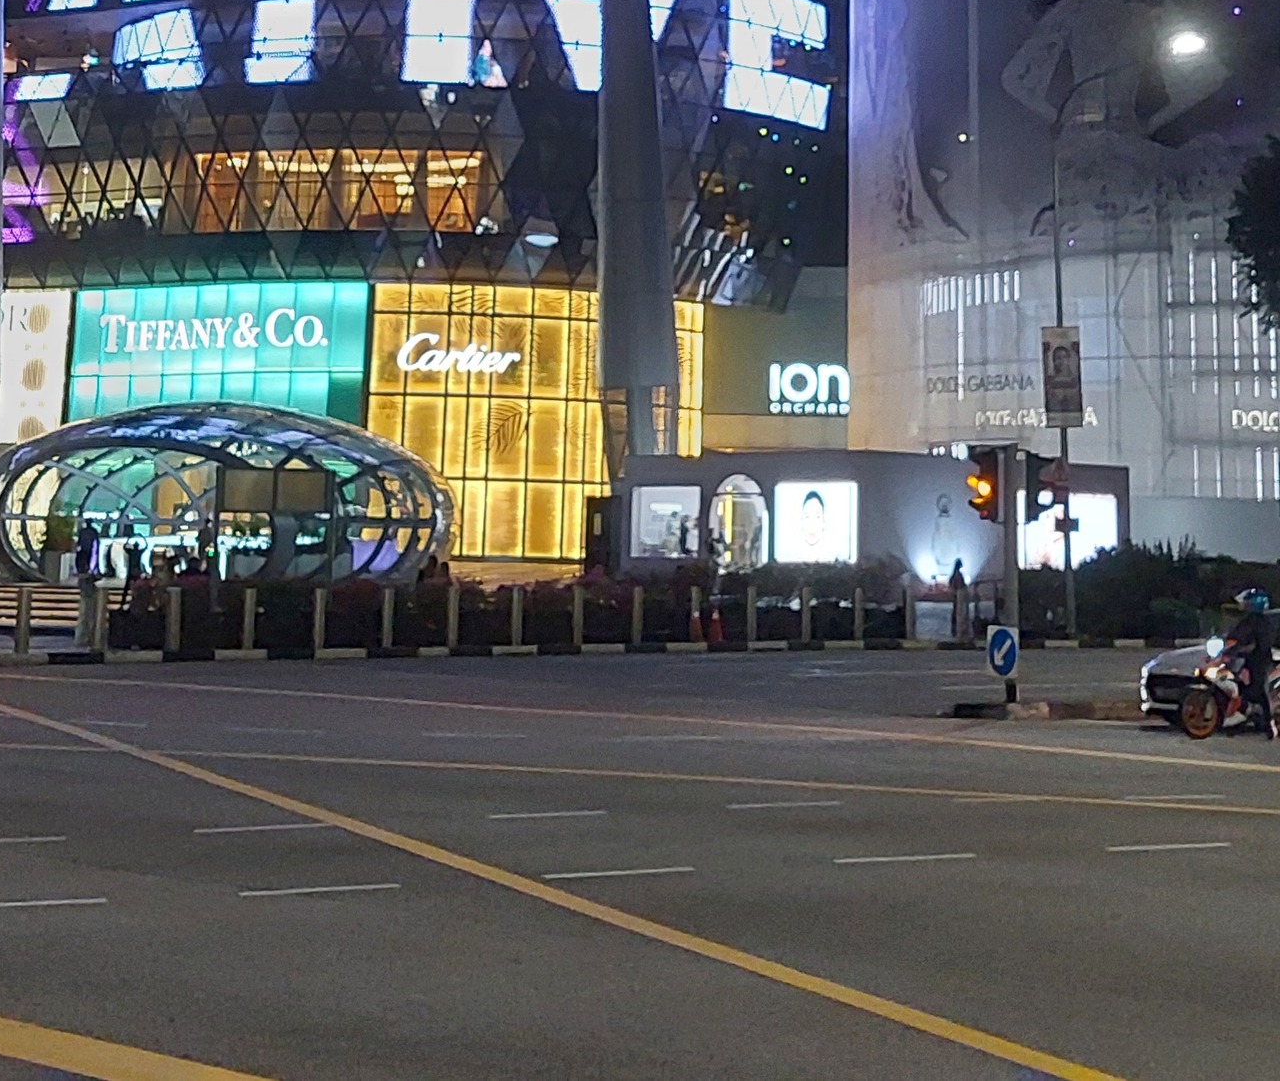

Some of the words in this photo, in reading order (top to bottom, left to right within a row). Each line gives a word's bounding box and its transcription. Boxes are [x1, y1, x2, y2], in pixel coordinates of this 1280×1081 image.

[100, 314, 232, 353] TIFFANY
[232, 312, 261, 349] &
[396, 332, 522, 374] Cartier
[768, 402, 851, 415] ORCHARD
